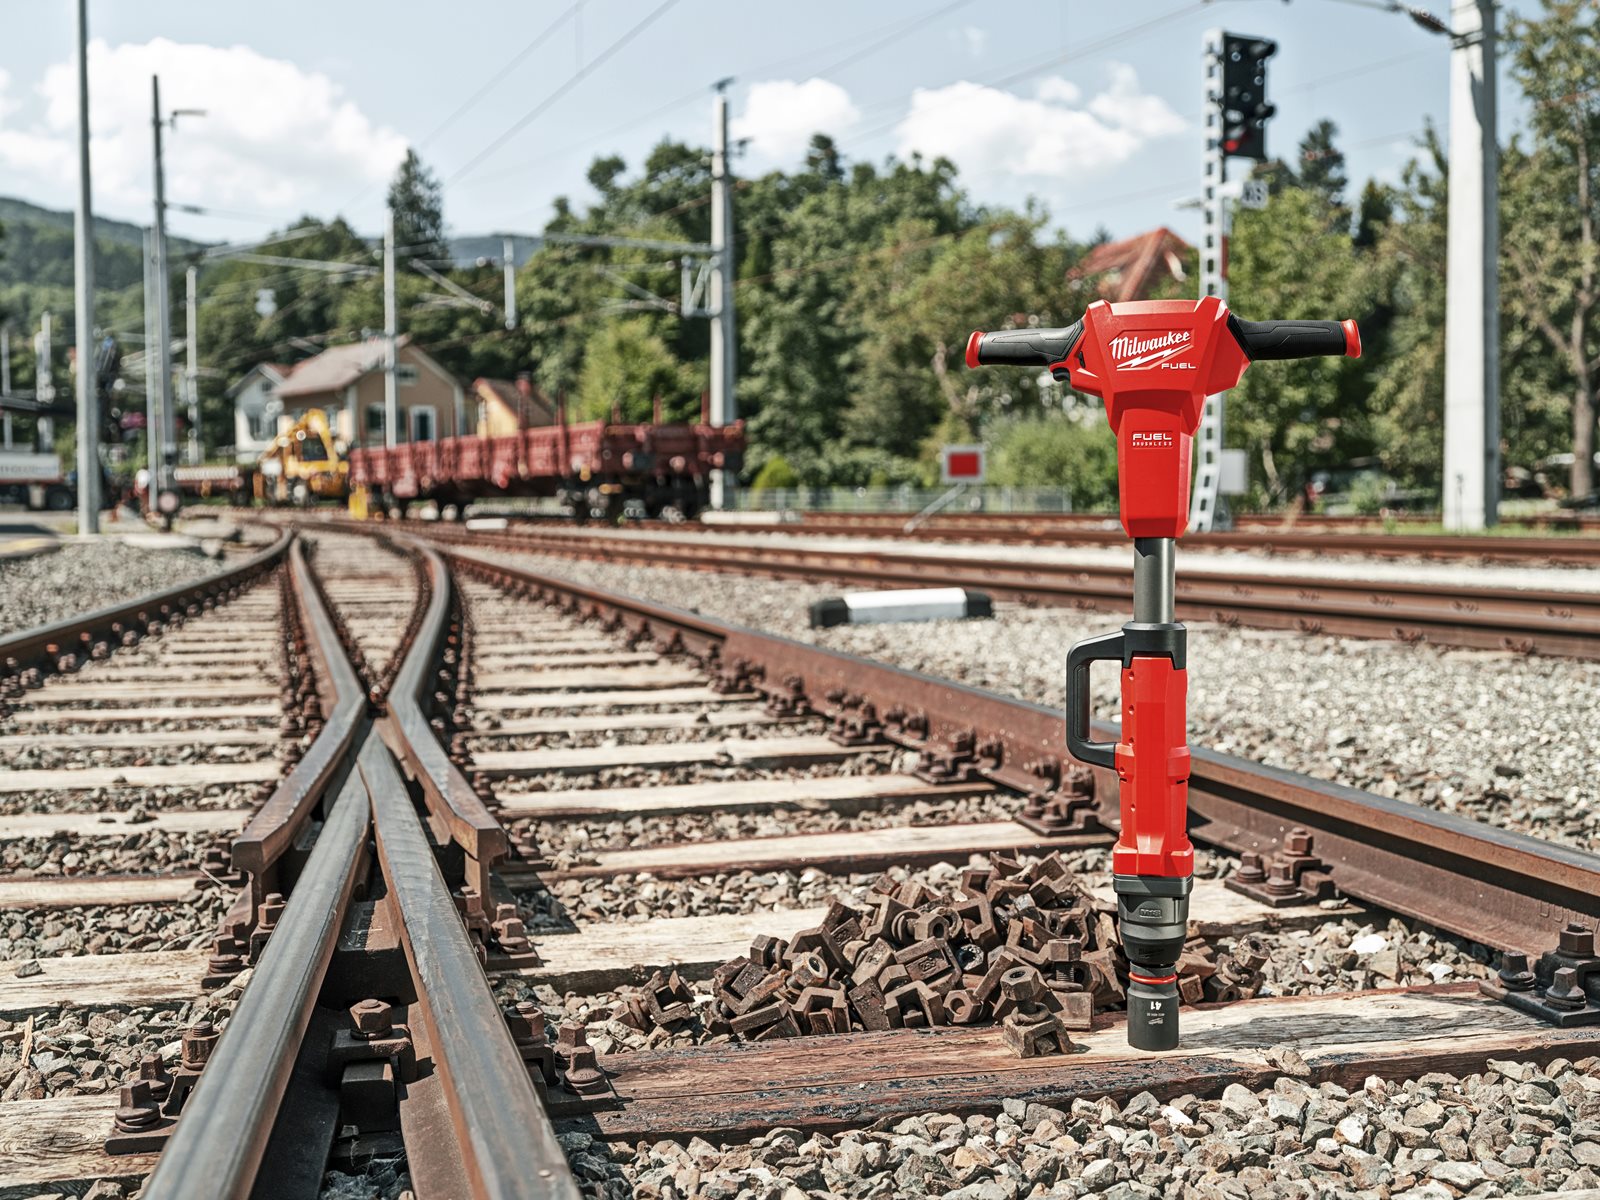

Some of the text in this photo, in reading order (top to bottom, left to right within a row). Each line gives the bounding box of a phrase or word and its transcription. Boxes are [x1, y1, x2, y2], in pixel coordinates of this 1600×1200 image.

[1108, 331, 1191, 360] Milwaukee
[1132, 433, 1172, 441] FUEL
[1150, 1001, 1162, 1011] 41
